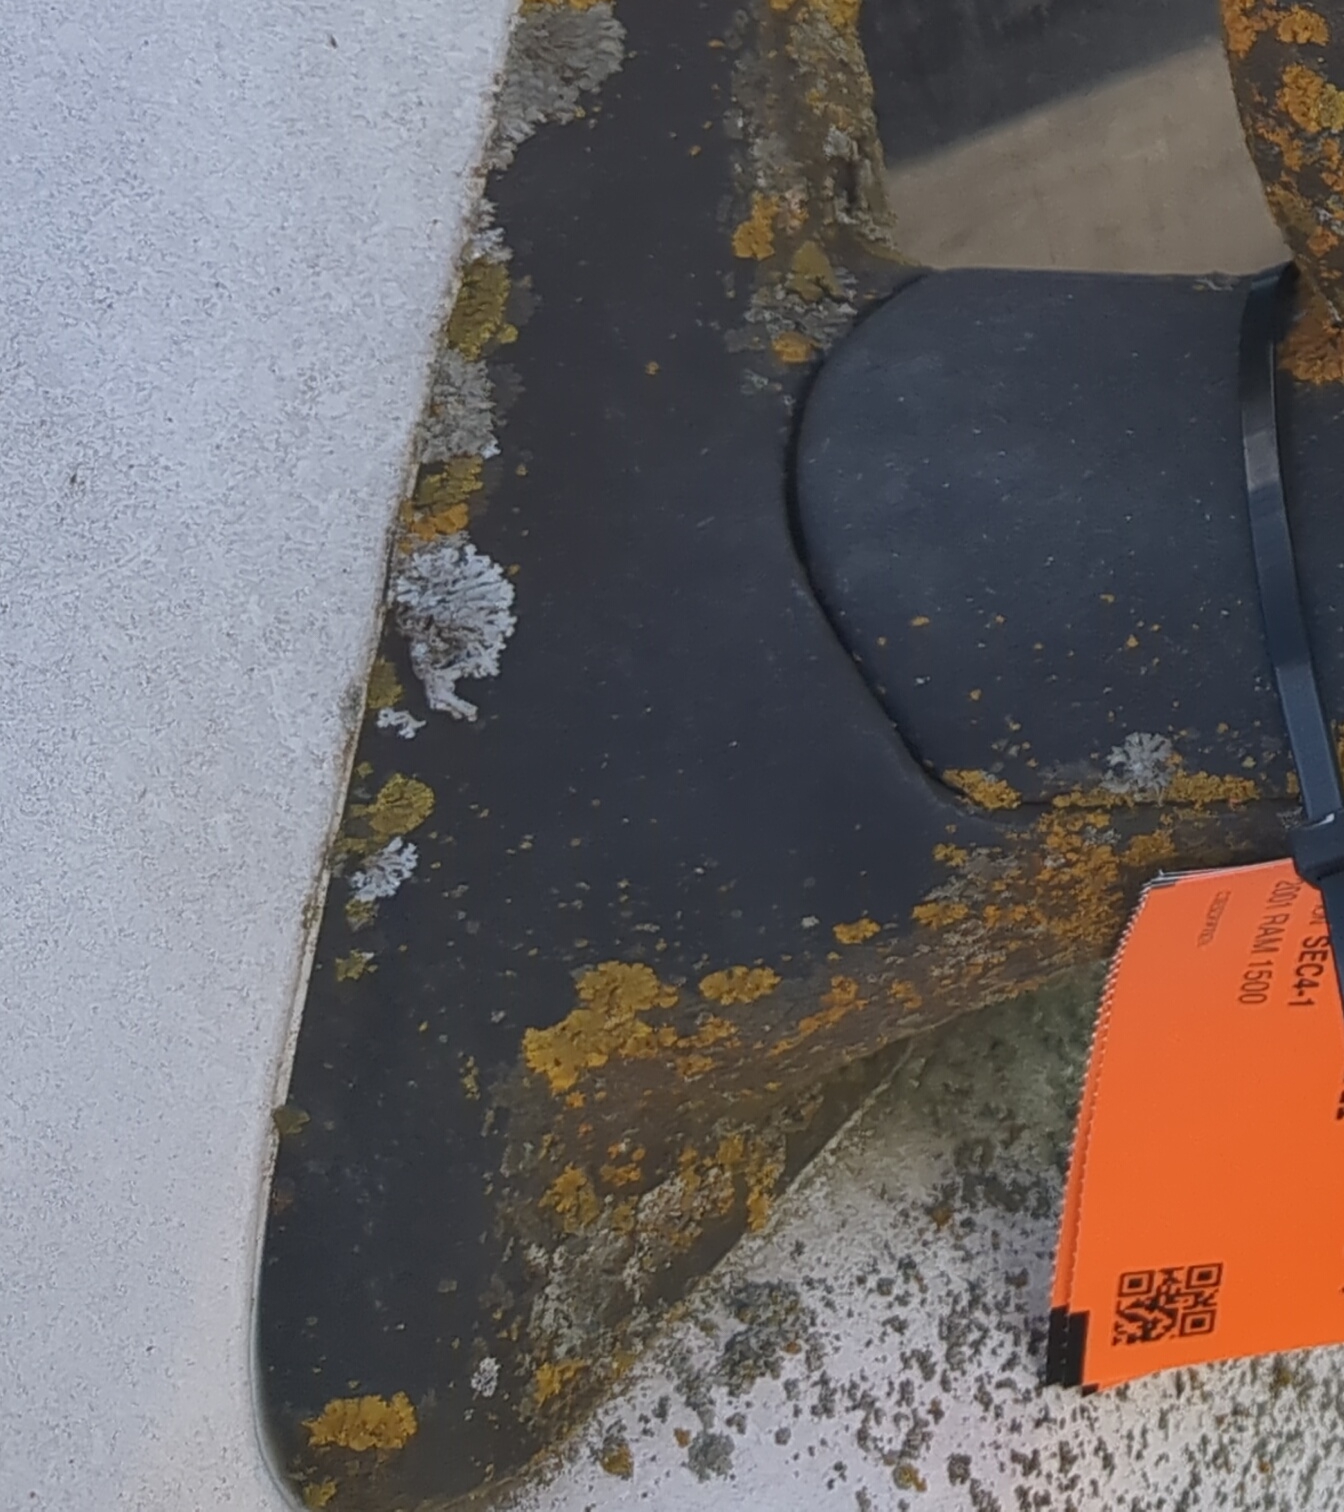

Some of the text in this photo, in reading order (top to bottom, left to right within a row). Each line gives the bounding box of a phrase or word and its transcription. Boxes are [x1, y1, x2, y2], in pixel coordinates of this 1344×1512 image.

[1250, 913, 1290, 954] RAM
[1237, 959, 1274, 1005] 1500
[1287, 935, 1335, 1007] SEC4-1
